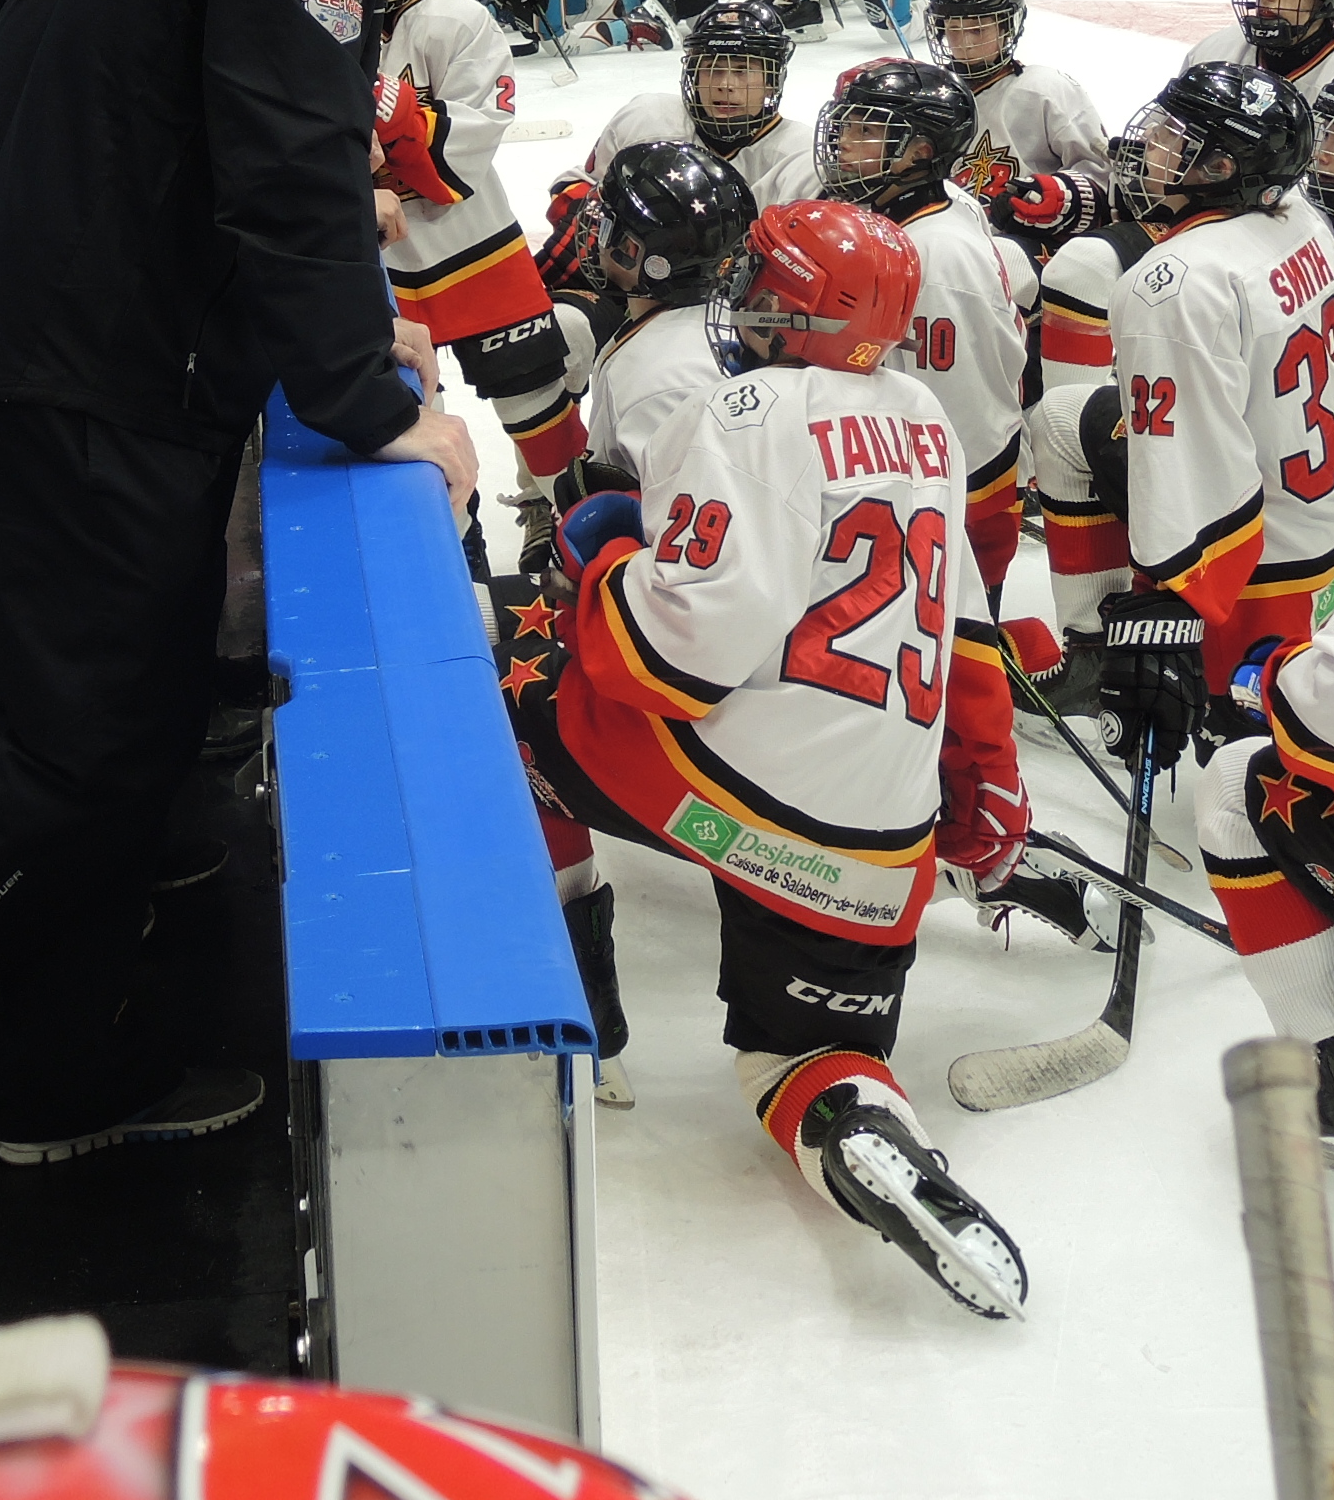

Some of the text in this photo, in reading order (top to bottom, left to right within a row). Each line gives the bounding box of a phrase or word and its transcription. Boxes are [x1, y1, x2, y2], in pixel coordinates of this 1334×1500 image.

[771, 247, 815, 283] BAUER
[1269, 236, 1334, 317] SMITH
[480, 314, 552, 353] CCM
[847, 342, 881, 367] 29
[912, 316, 956, 372] 10
[1130, 374, 1176, 436] 32
[655, 493, 734, 570] 29
[779, 497, 947, 729] 29
[1106, 618, 1205, 647] WARRIO
[736, 831, 842, 884] Desjardins
[726, 853, 901, 922] Caisse de Salaberry-de-Valleyfield
[784, 976, 895, 1016] CCM
